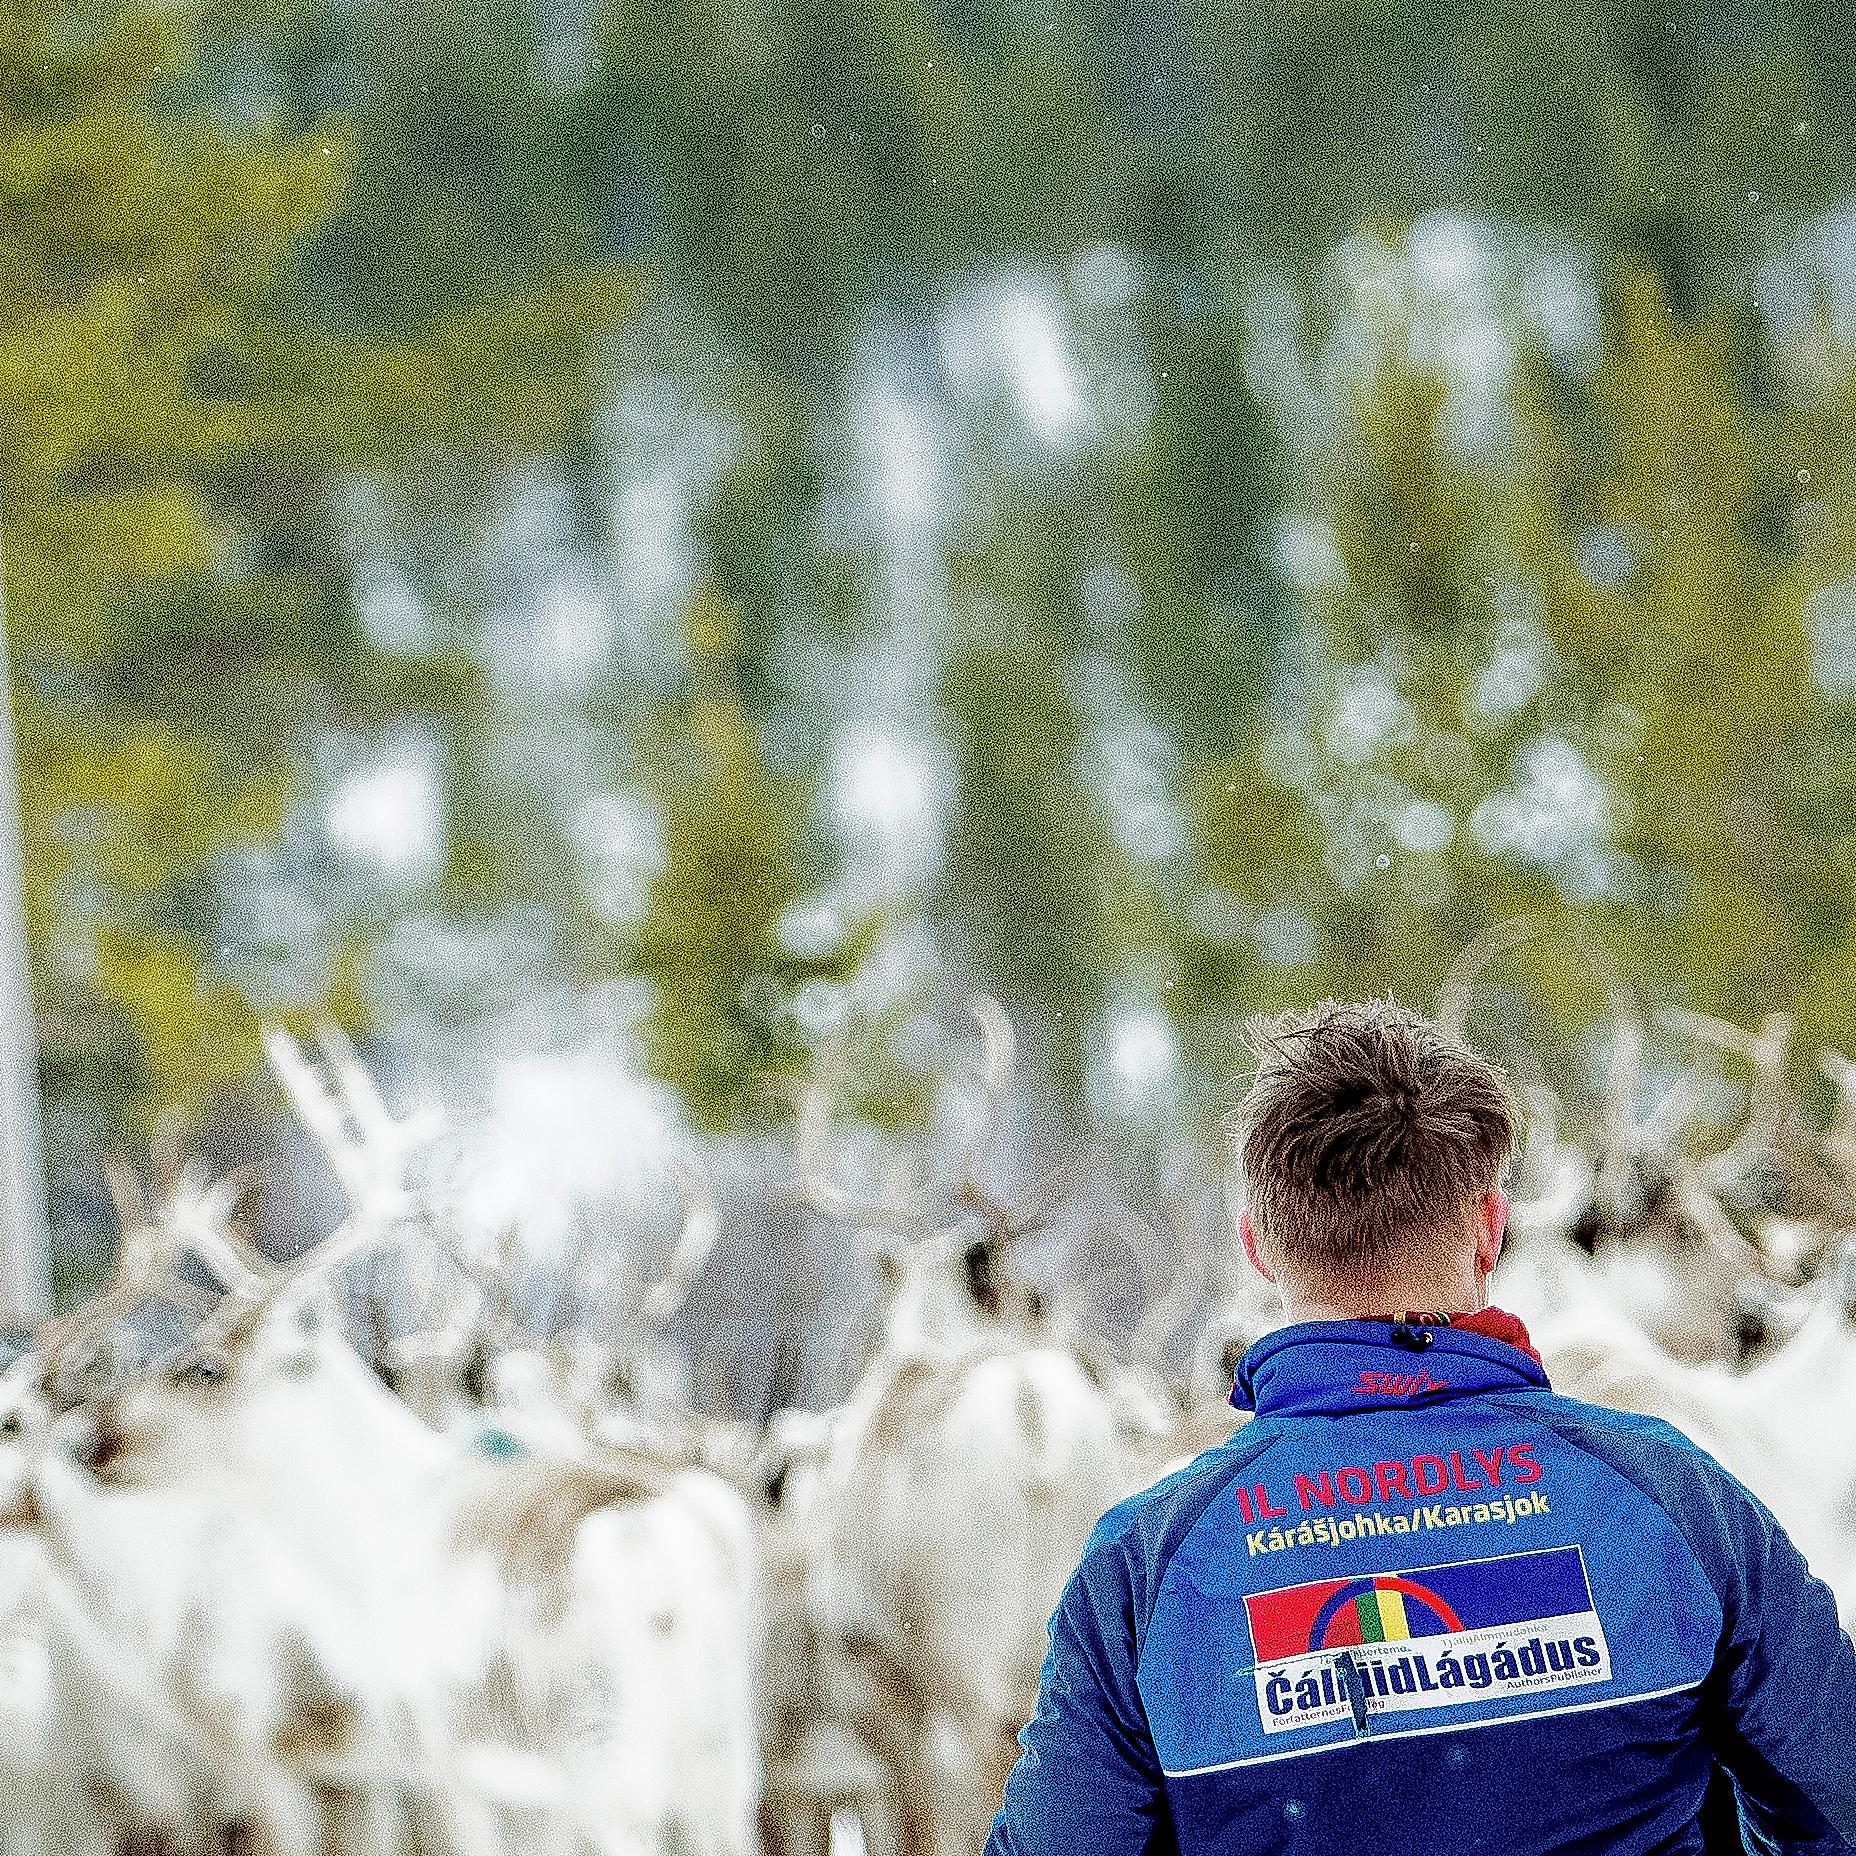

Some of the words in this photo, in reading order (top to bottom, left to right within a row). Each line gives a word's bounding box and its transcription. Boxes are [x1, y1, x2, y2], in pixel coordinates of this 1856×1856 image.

[1236, 1483, 1287, 1524] IL
[1294, 1443, 1543, 1511] NORDLYS
[1246, 1490, 1551, 1557] Kárášjohka/Karasjok
[1507, 1667, 1602, 1690] AuthorsPublisher
